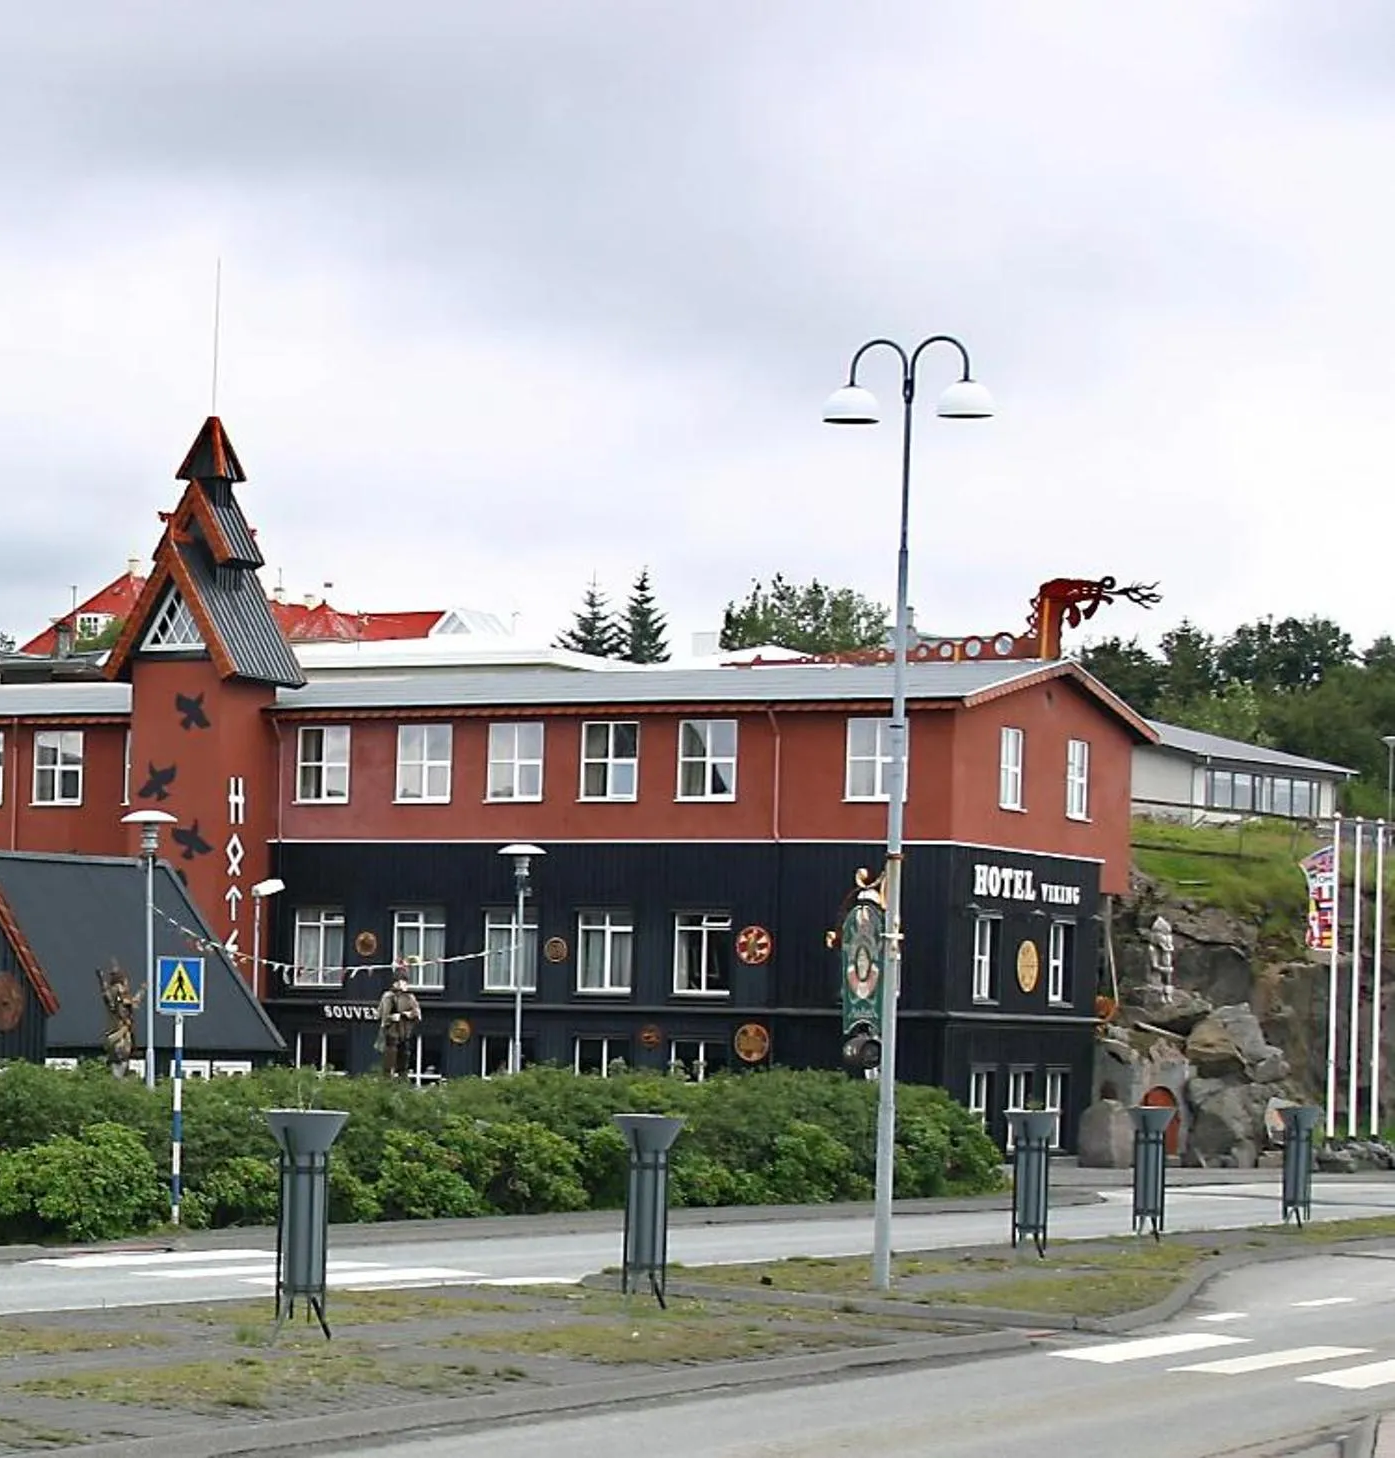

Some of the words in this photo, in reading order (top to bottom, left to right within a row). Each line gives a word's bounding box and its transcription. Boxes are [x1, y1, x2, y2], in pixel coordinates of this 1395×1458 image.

[973, 864, 1036, 901] HOTEL
[1041, 883, 1080, 905] VIKING
[324, 1005, 379, 1020] SOUVEN
